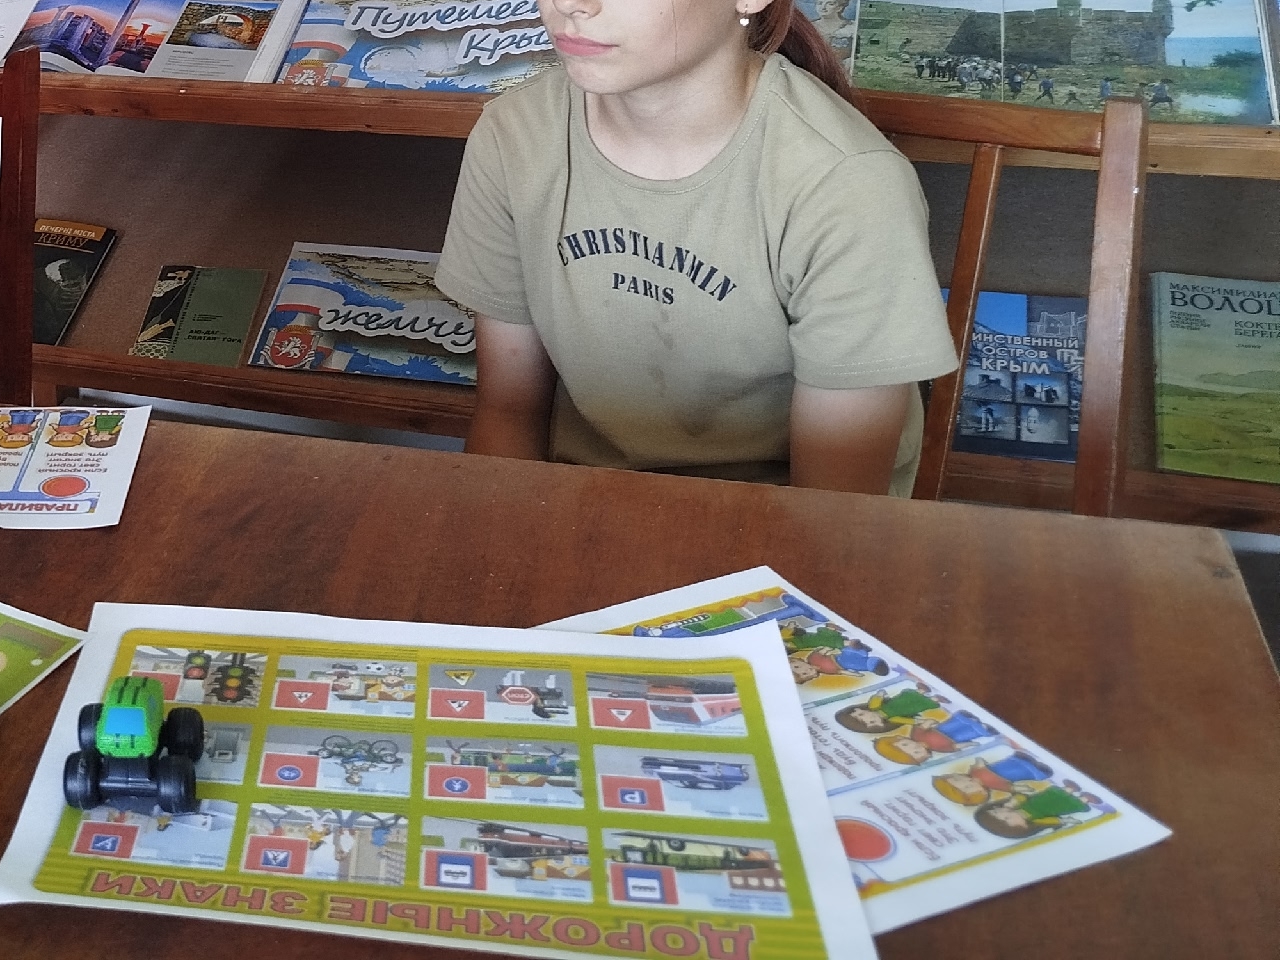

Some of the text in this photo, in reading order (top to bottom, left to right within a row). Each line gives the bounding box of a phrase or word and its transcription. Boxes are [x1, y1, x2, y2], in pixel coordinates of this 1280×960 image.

[351, 0, 540, 33] Путешес
[38, 233, 89, 247] КРИМУ
[557, 227, 737, 302] CHRISTIANMIN
[611, 272, 674, 305] PARIS
[1169, 282, 1280, 300] МАКСИМИЛИА
[971, 332, 1079, 348] ИНСТВЕННЫЙ
[982, 346, 1048, 359] ОСТРОВ
[981, 358, 1050, 375] КРЫМ
[89, 871, 755, 959] ДОРОЖНЫЕ ЗНАКИ
